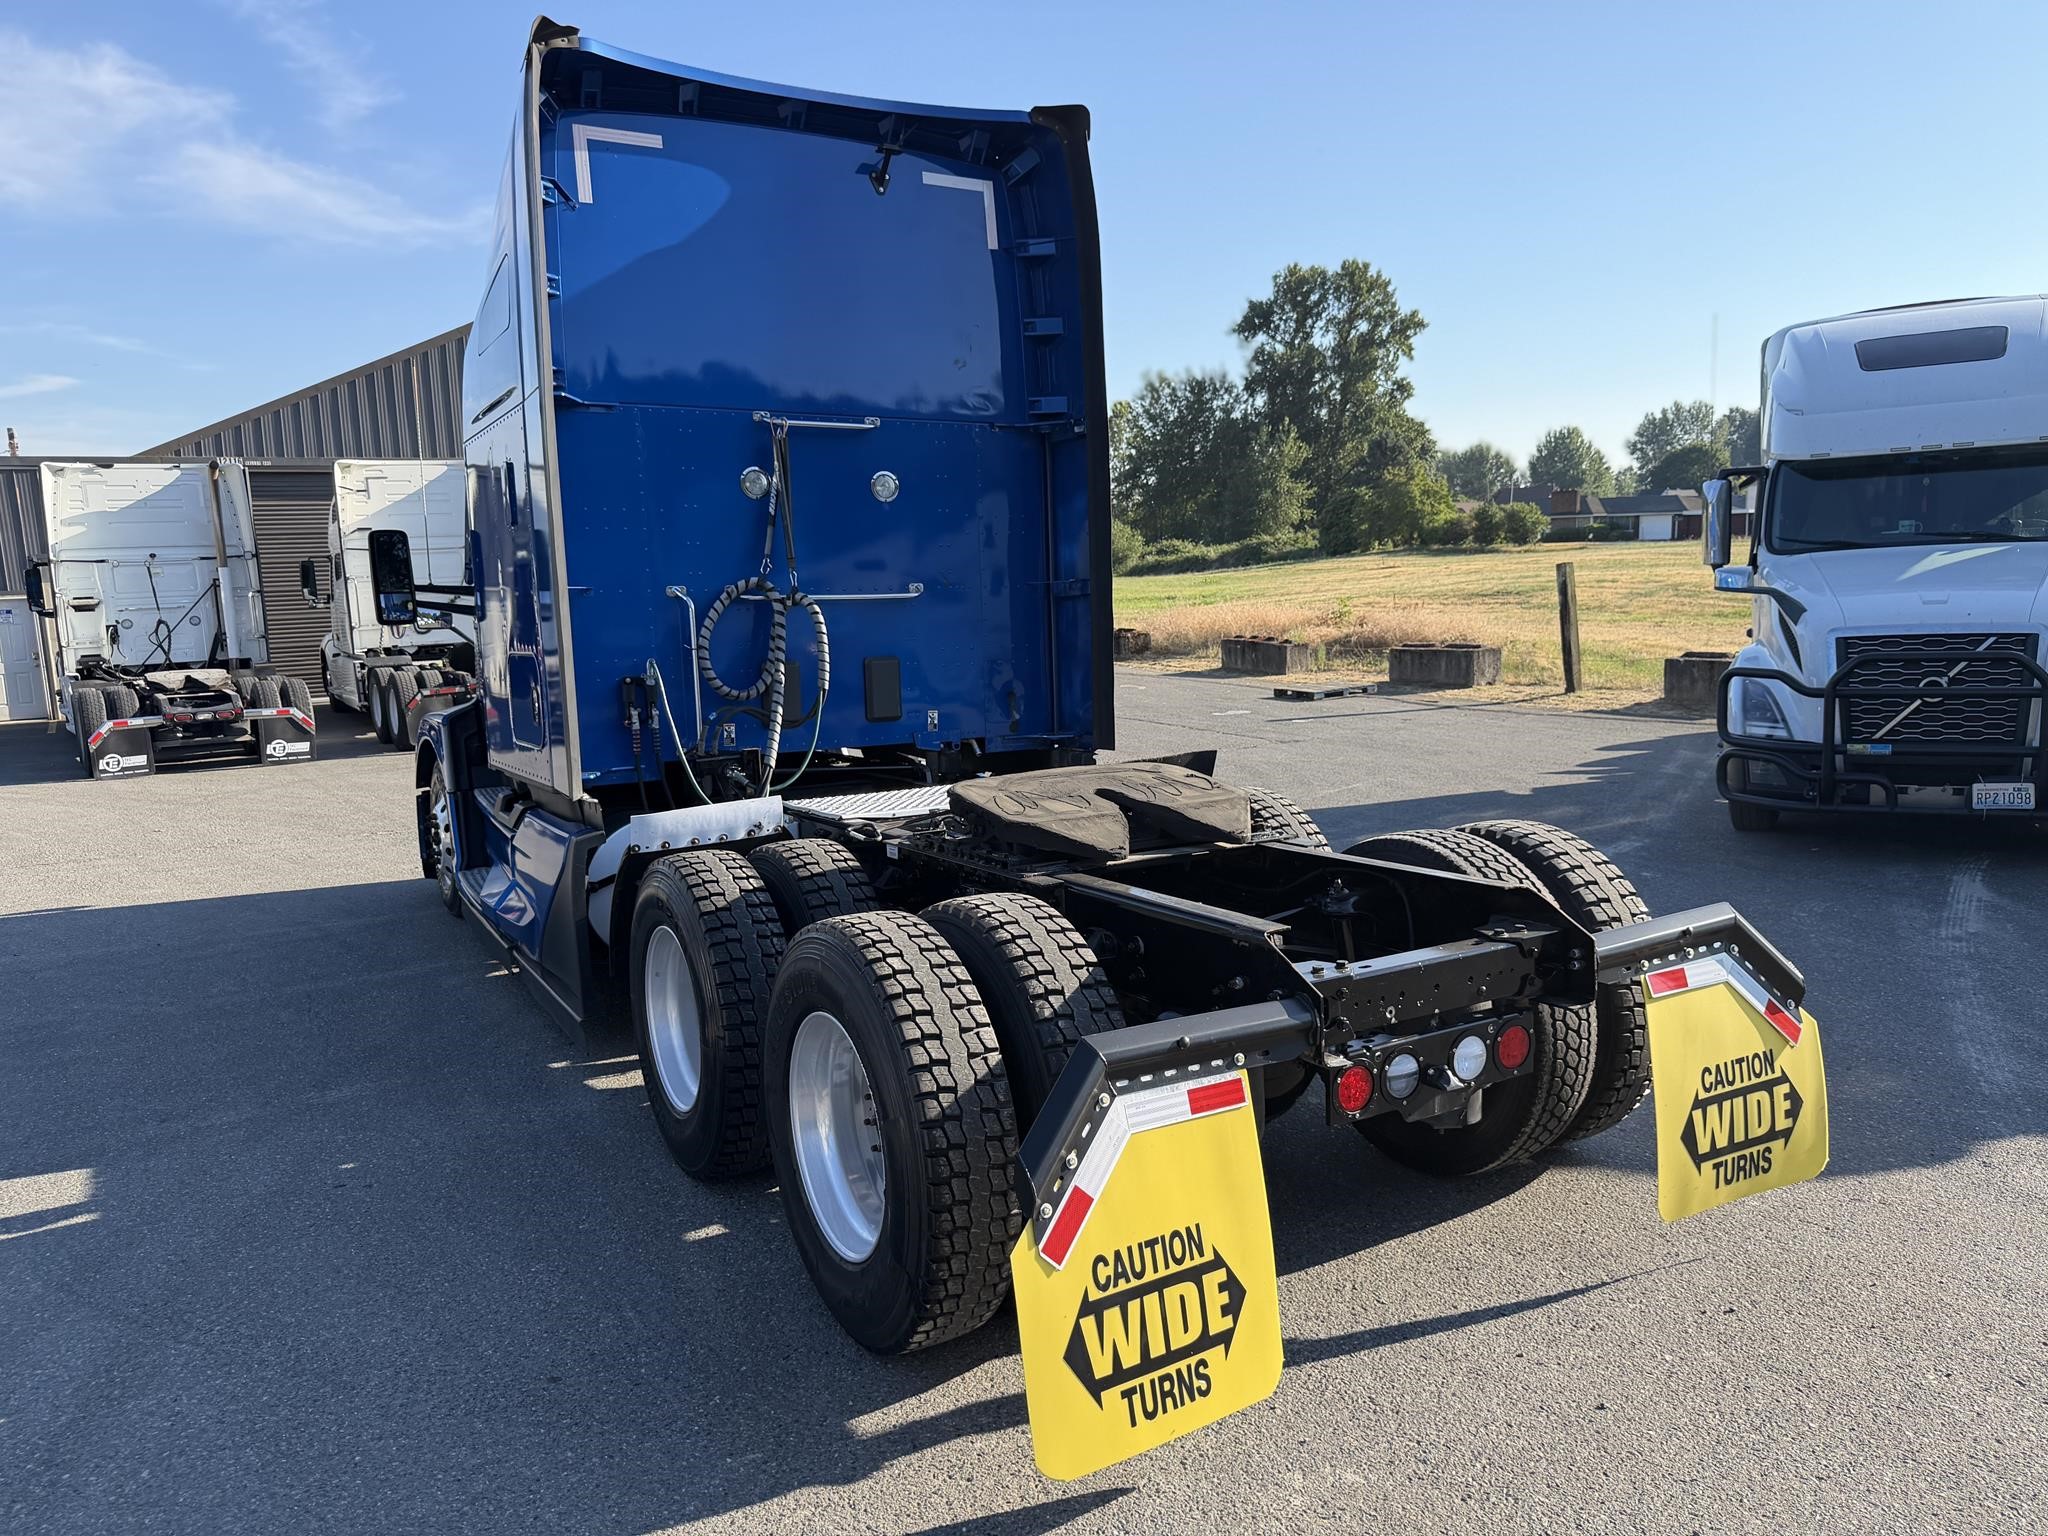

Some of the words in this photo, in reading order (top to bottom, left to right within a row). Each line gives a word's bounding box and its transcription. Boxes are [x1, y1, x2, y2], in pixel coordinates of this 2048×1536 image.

[1976, 792, 2032, 805] RP21098
[1701, 1049, 1776, 1094] CAUTION
[1691, 1082, 1794, 1155] WIDE
[1712, 1146, 1772, 1189] TURNS
[1092, 1223, 1205, 1293] CAUTION
[1079, 1267, 1234, 1381] WIDE
[1121, 1359, 1212, 1428] TURNS
